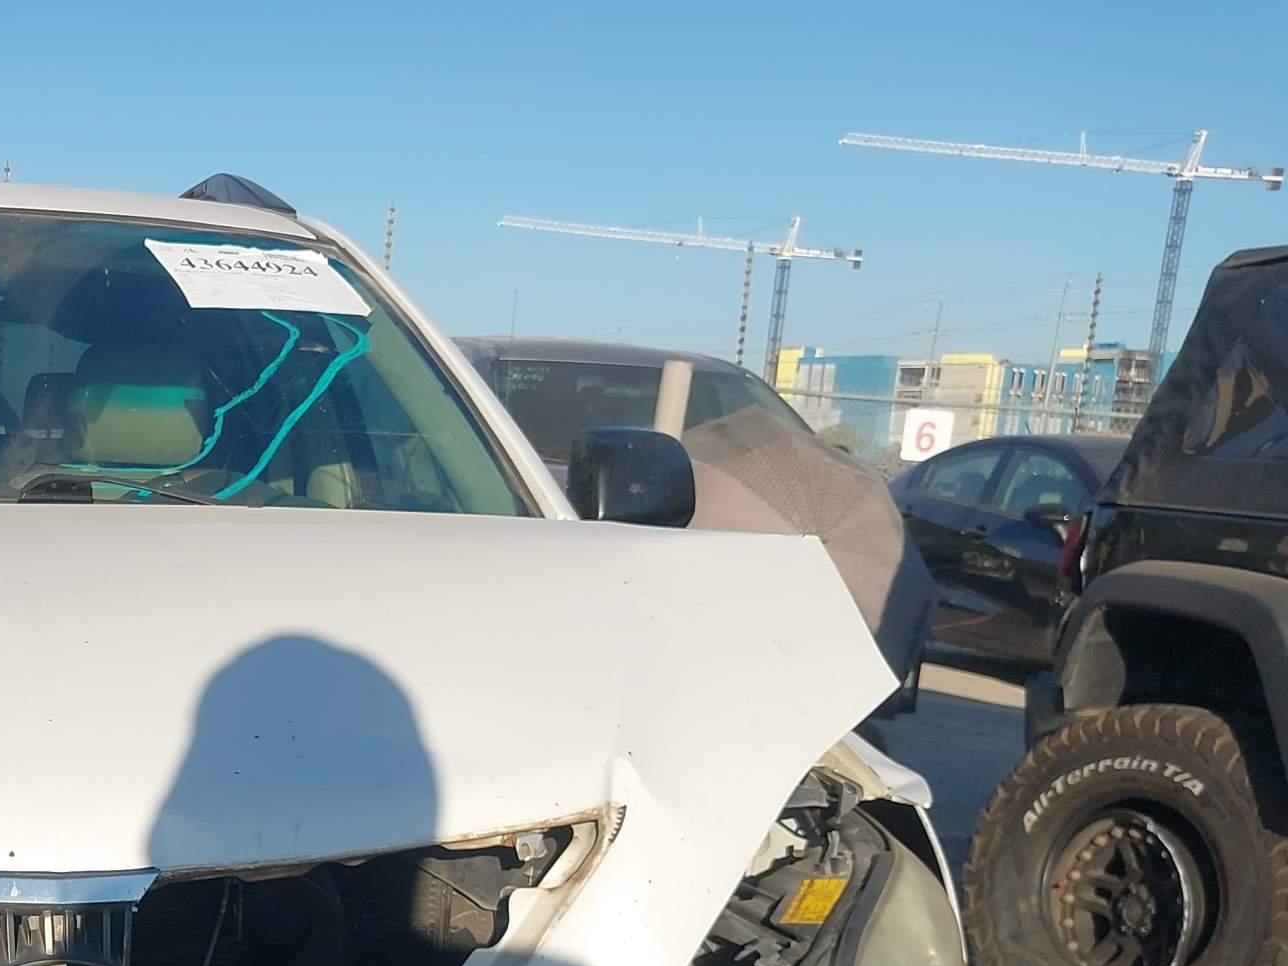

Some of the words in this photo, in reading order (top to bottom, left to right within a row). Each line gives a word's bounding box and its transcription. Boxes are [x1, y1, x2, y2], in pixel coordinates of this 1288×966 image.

[179, 257, 319, 278] 43644924
[915, 421, 937, 452] 6
[1023, 755, 1158, 834] All-Terrain
[1162, 762, 1205, 797] T/A
